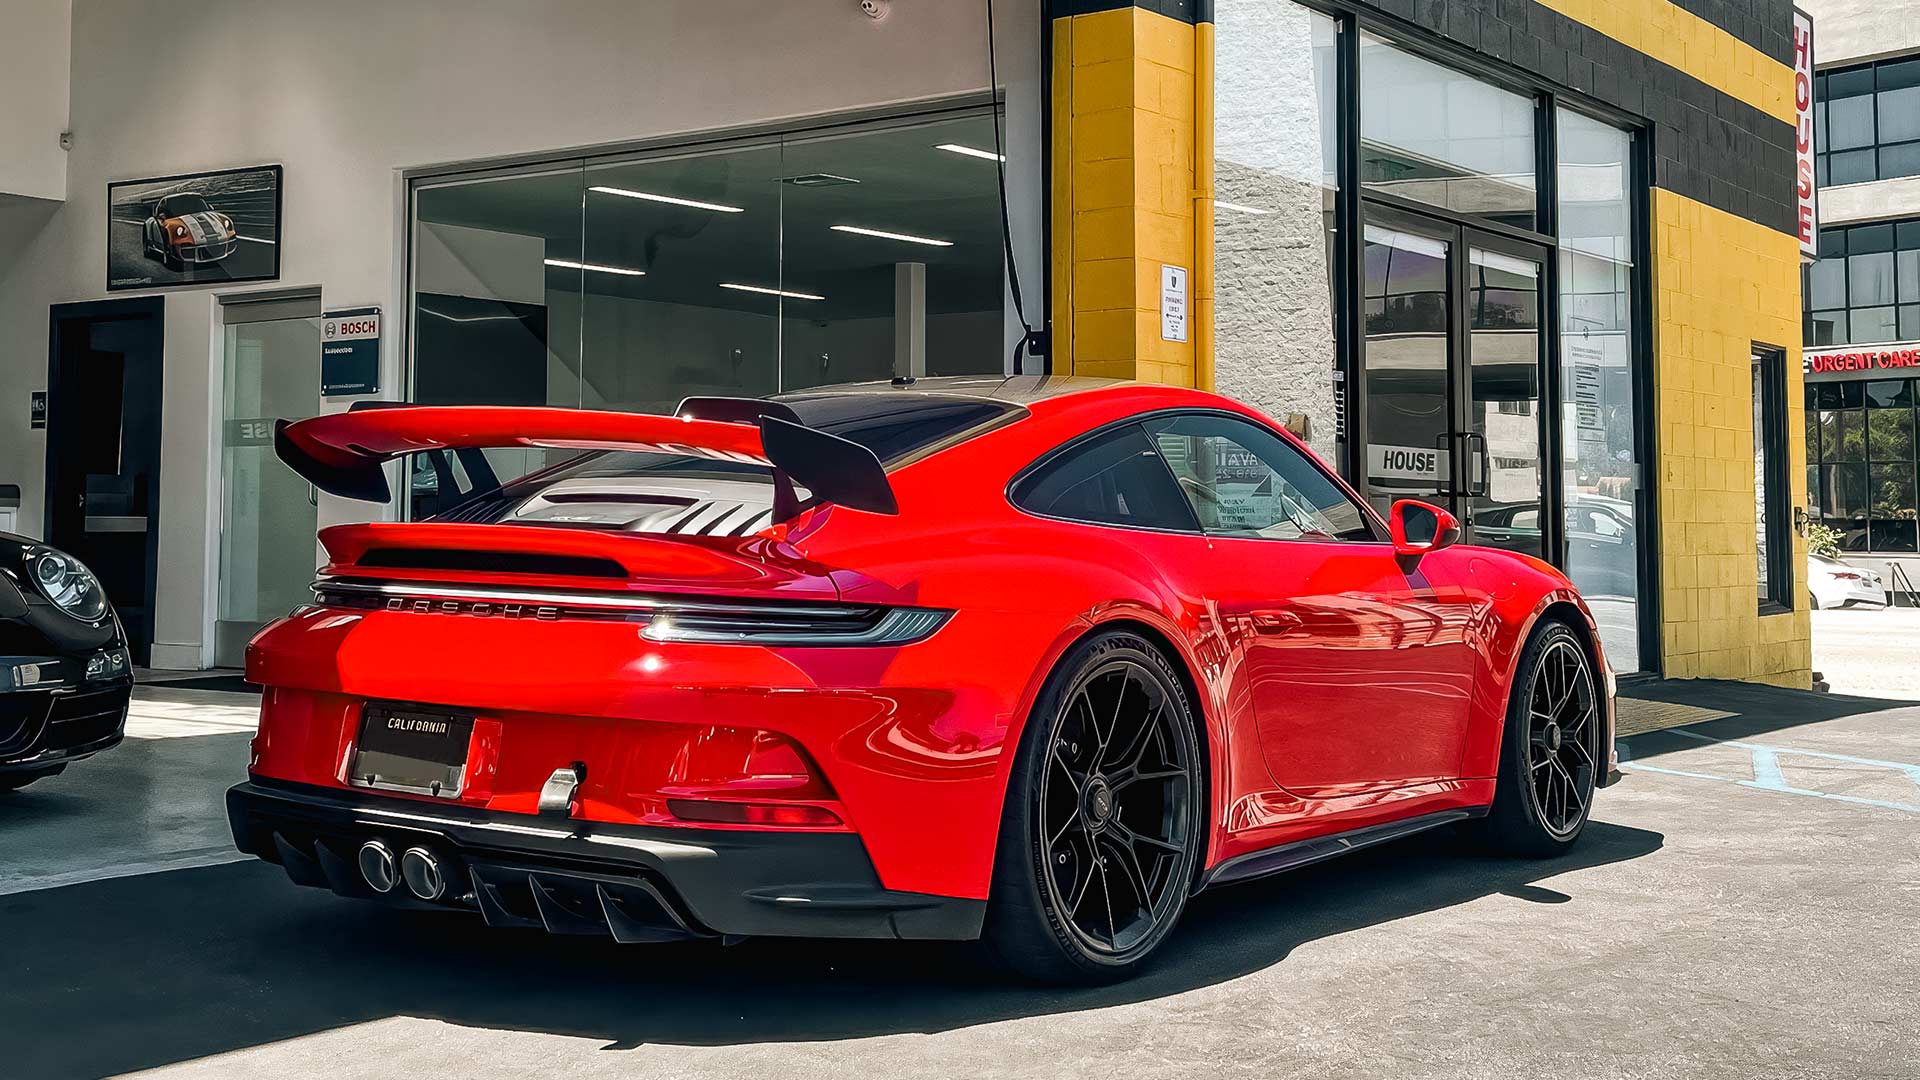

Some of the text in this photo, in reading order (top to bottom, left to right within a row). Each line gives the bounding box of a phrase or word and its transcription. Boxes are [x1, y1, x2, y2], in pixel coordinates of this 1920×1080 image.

[1794, 25, 1813, 245] HOUSE
[341, 320, 376, 335] BOSCH
[1812, 352, 1876, 373] URGENT
[1877, 349, 1920, 369] CARE
[1383, 450, 1435, 472] HOUSE
[387, 717, 447, 734] CALIFORNIA
